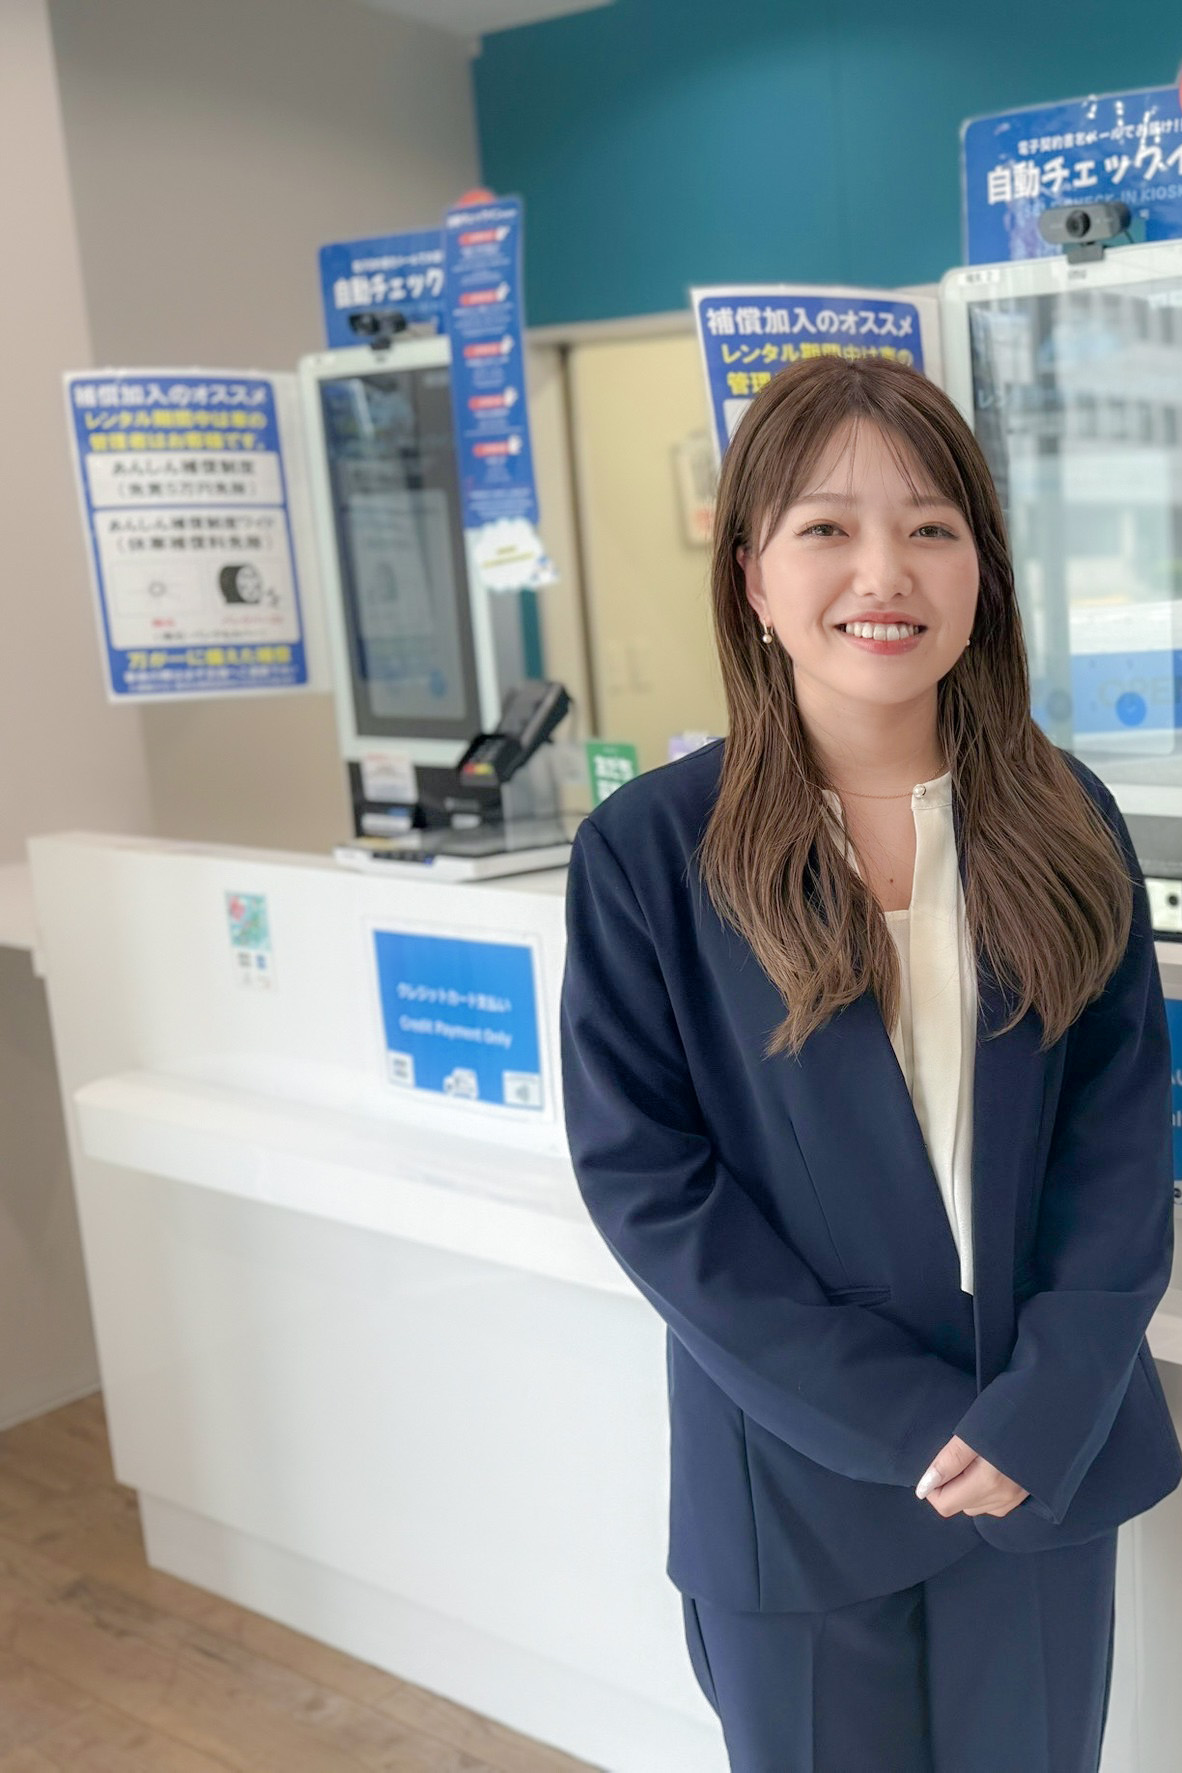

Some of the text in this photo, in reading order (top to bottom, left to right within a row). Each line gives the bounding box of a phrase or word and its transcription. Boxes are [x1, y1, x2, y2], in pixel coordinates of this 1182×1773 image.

[706, 307, 913, 337] 補償加入のオススメ
